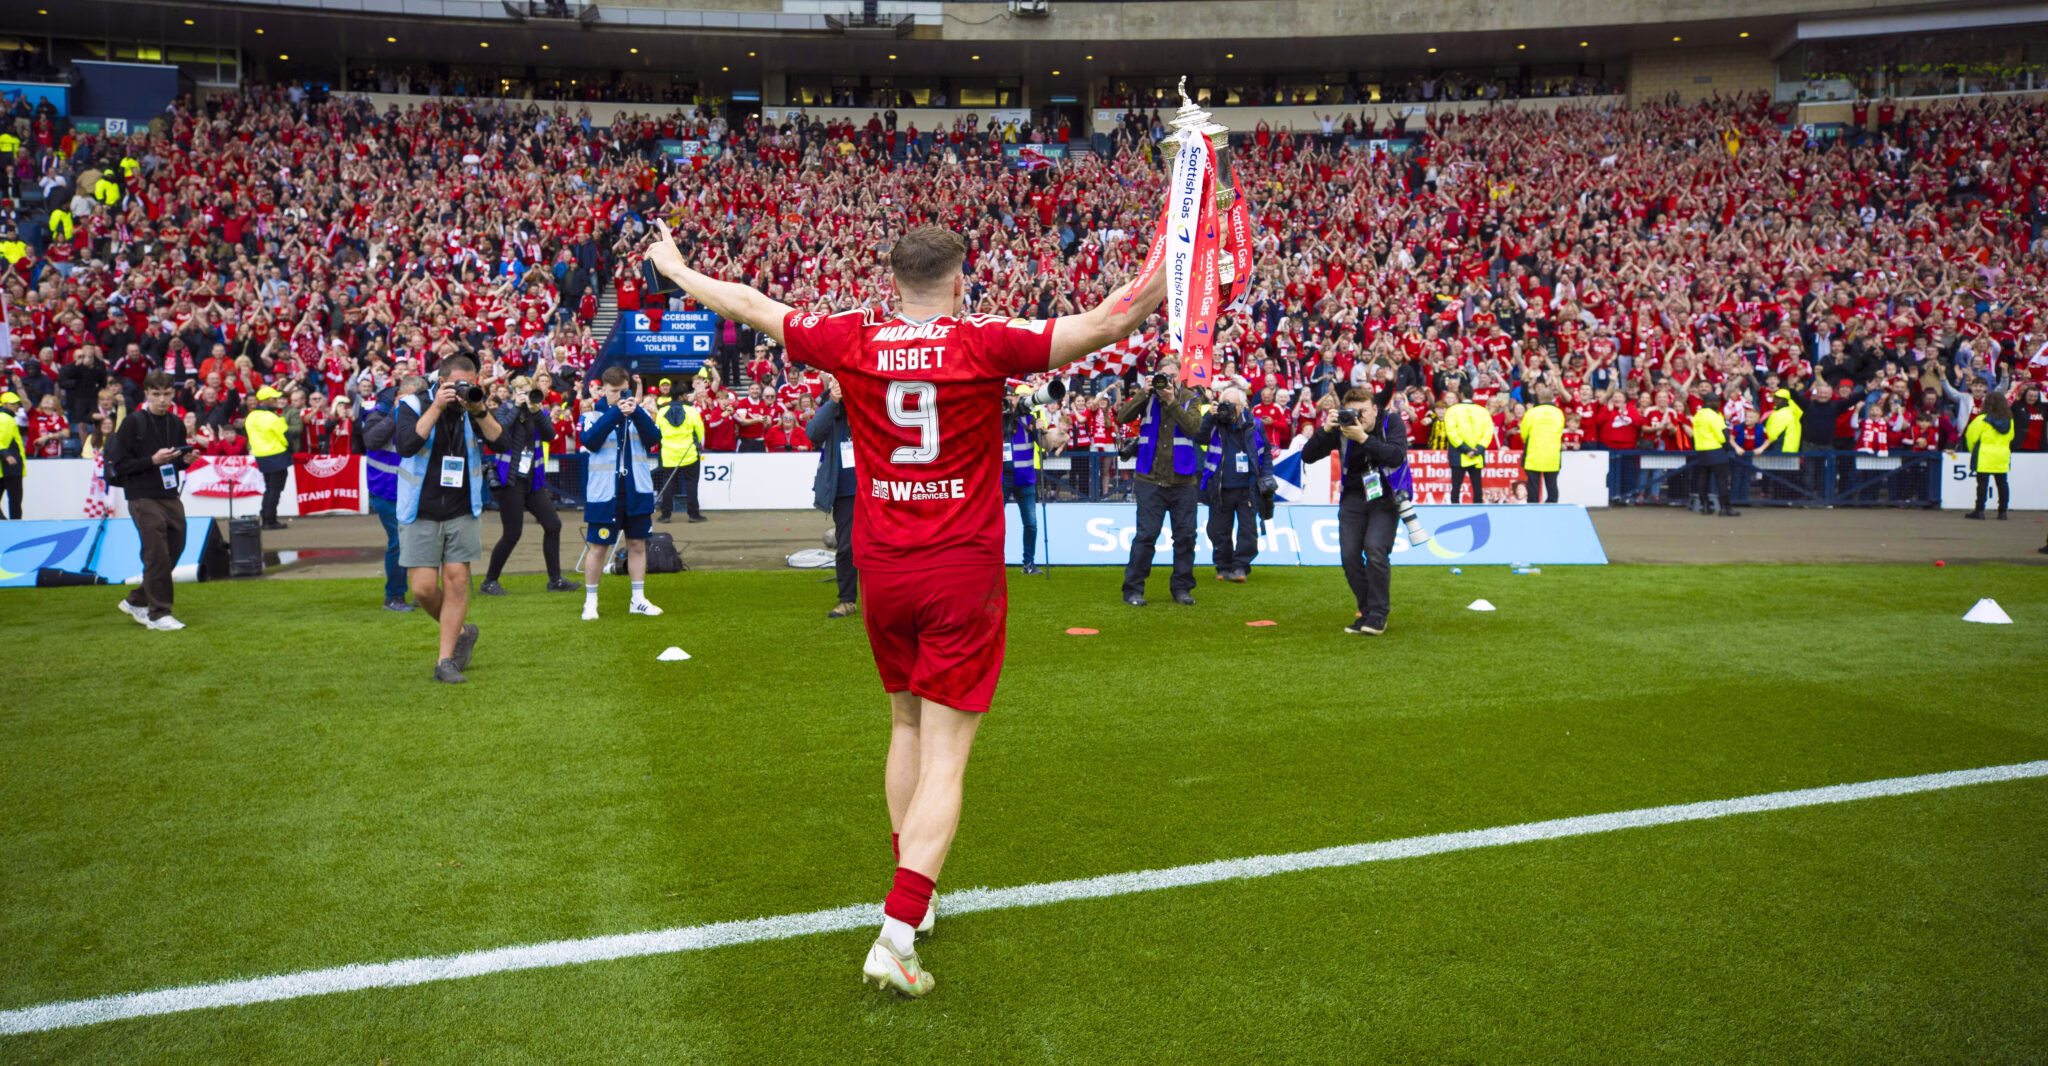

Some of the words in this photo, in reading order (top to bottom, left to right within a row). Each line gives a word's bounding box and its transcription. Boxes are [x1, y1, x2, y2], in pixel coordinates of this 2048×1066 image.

[108, 121, 125, 131] 51
[1185, 146, 1201, 195] Scottish
[1181, 197, 1194, 219] Gas
[1232, 205, 1247, 248] Scottish
[1238, 248, 1248, 269] Gas
[1174, 252, 1187, 296] Scottish
[1205, 248, 1215, 295] Scottish
[1174, 296, 1184, 318] Gas
[1200, 296, 1214, 317] Gas
[877, 346, 946, 371] NISBET
[885, 380, 940, 464] 9
[1418, 450, 1449, 464] lads
[1498, 450, 1521, 464] for
[704, 465, 730, 481] 52
[297, 489, 331, 503] STAND
[334, 488, 358, 498] FREE
[890, 478, 965, 501] WASTE
[912, 493, 949, 501] SERVICES
[1312, 519, 1410, 553] Gs
